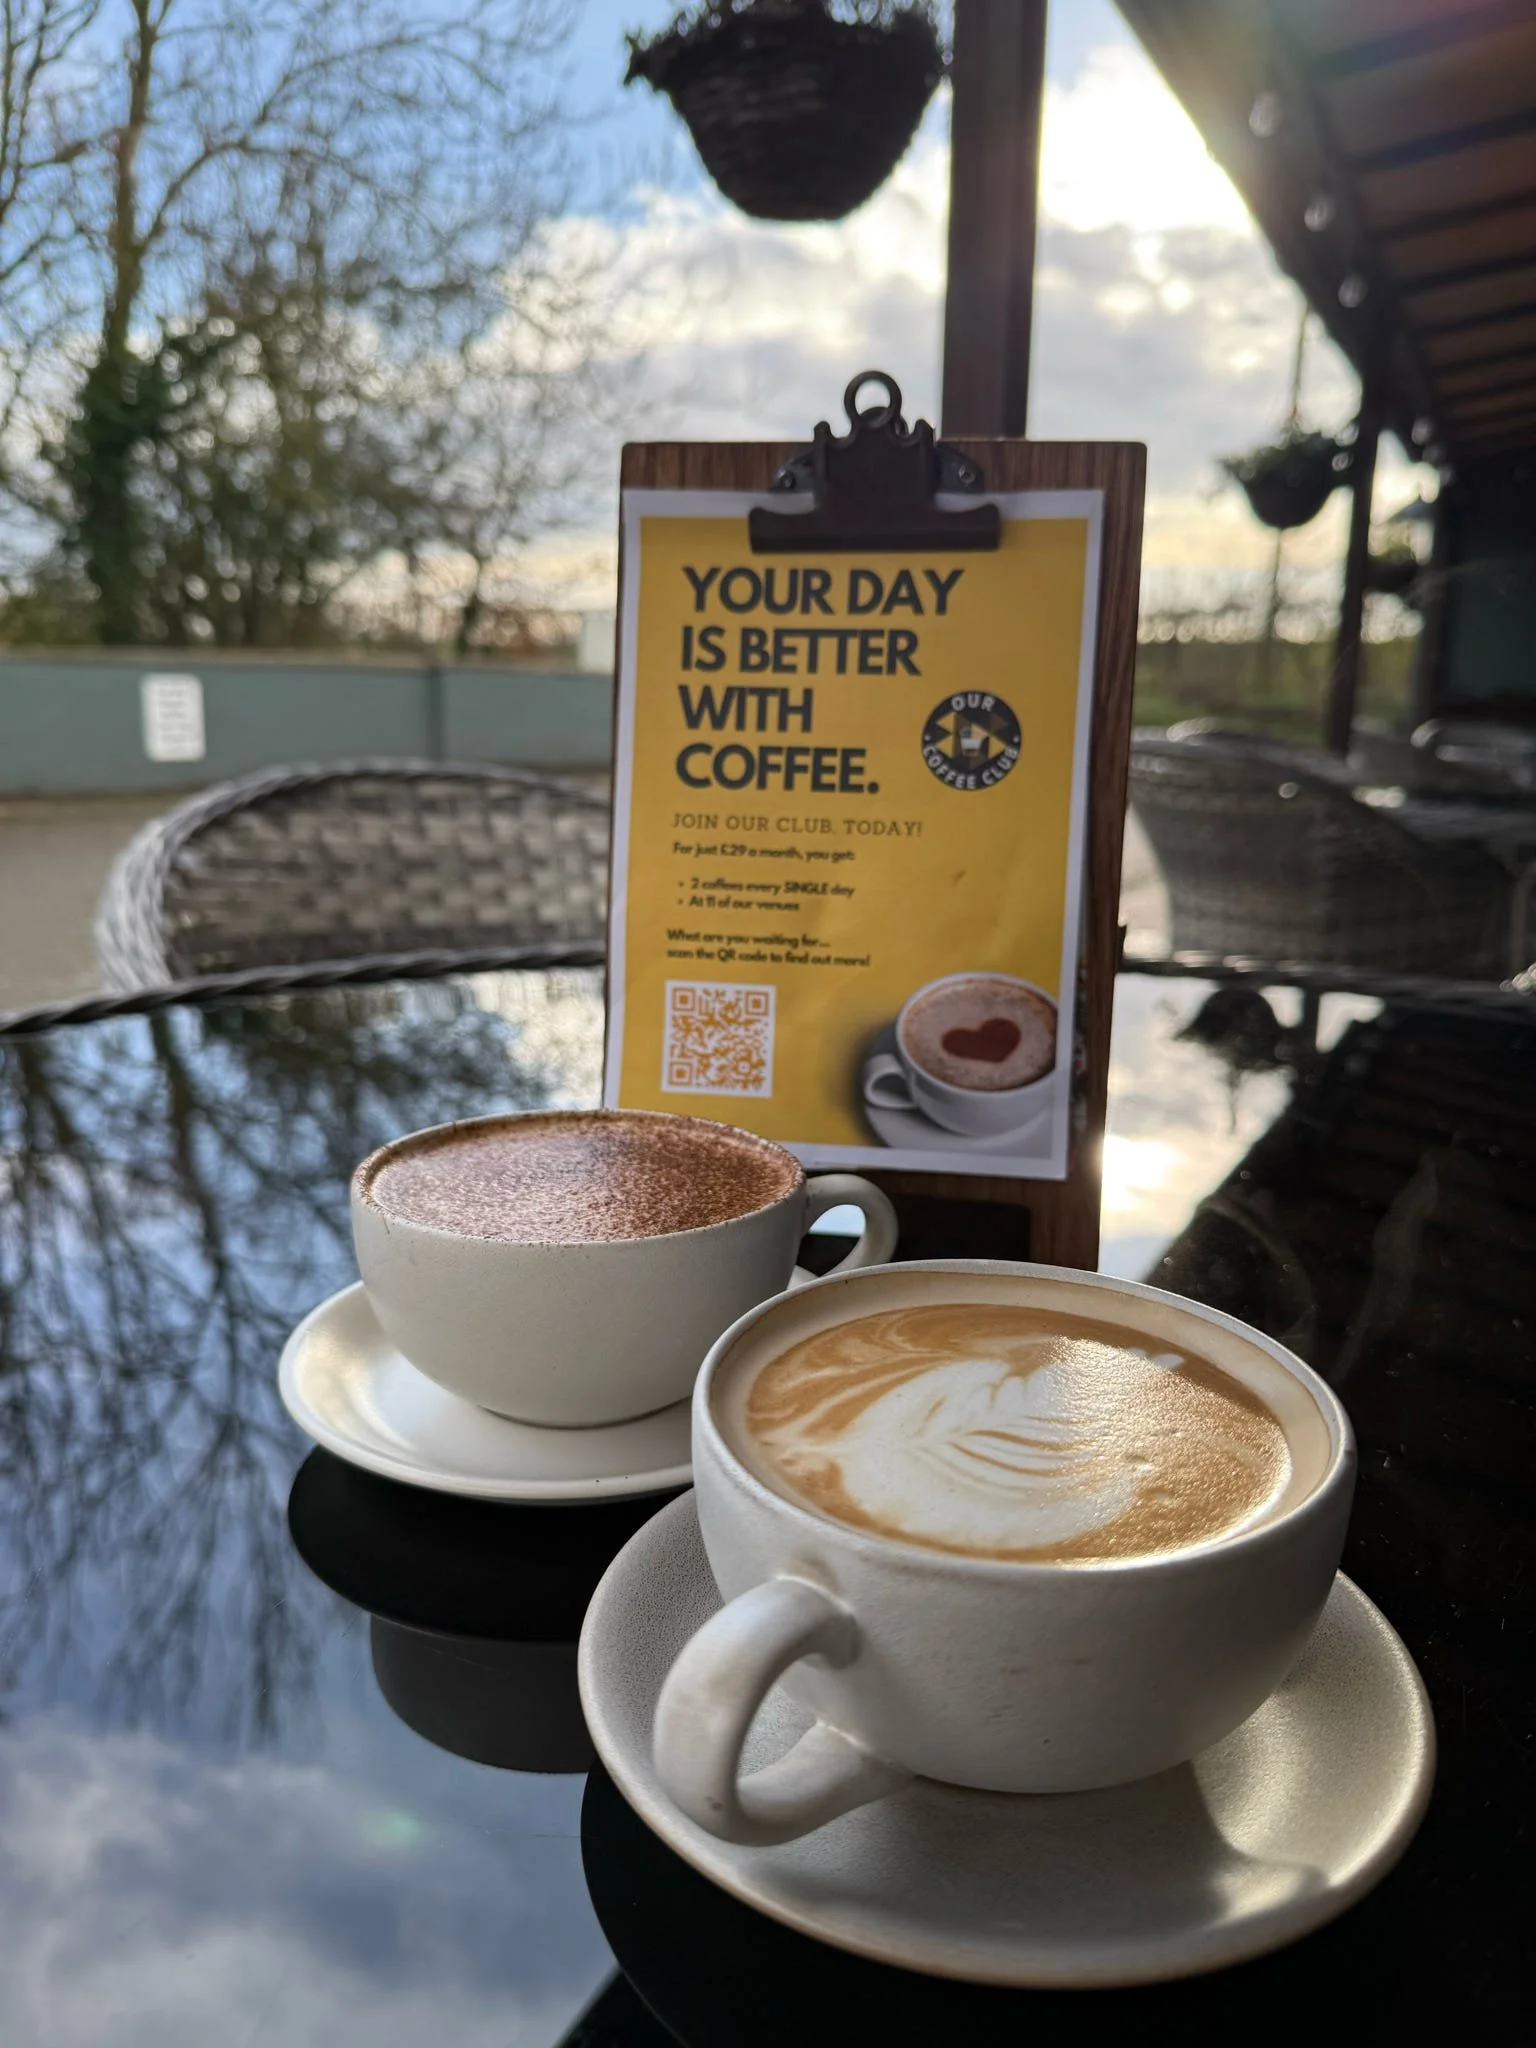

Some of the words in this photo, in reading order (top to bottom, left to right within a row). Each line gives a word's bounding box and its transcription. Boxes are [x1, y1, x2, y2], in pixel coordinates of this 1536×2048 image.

[682, 566, 835, 615] YOUR
[847, 568, 965, 616] DAY
[681, 625, 727, 673] IS
[739, 627, 922, 676] BETTER
[678, 684, 813, 733] WITH
[951, 693, 996, 712] OUR
[676, 743, 880, 794] COFFEE.
[923, 745, 977, 790] COFFEE
[981, 746, 1018, 786] CLUB
[672, 813, 719, 830] JOIN
[725, 815, 769, 832] OUR
[842, 819, 923, 838] TODAY!
[673, 842, 693, 855] For
[694, 843, 718, 858] just
[720, 843, 747, 856] £29
[805, 850, 829, 863] you
[690, 876, 700, 891] 2
[701, 877, 743, 892] coffees
[745, 882, 780, 896] every
[783, 881, 828, 896] SINGLE
[829, 882, 856, 898] day
[689, 895, 704, 908] At
[717, 896, 731, 908] of
[732, 899, 752, 909] our
[754, 901, 800, 912] venues
[667, 928, 701, 942] What
[702, 933, 724, 944] are
[725, 934, 750, 947] you
[751, 934, 800, 950] waiting
[667, 949, 694, 959] scan
[695, 947, 715, 960] the
[716, 947, 737, 963] QR
[738, 950, 768, 962] code
[769, 952, 783, 963] to
[784, 951, 810, 965] find
[811, 954, 832, 966] out
[833, 954, 872, 969] more!
